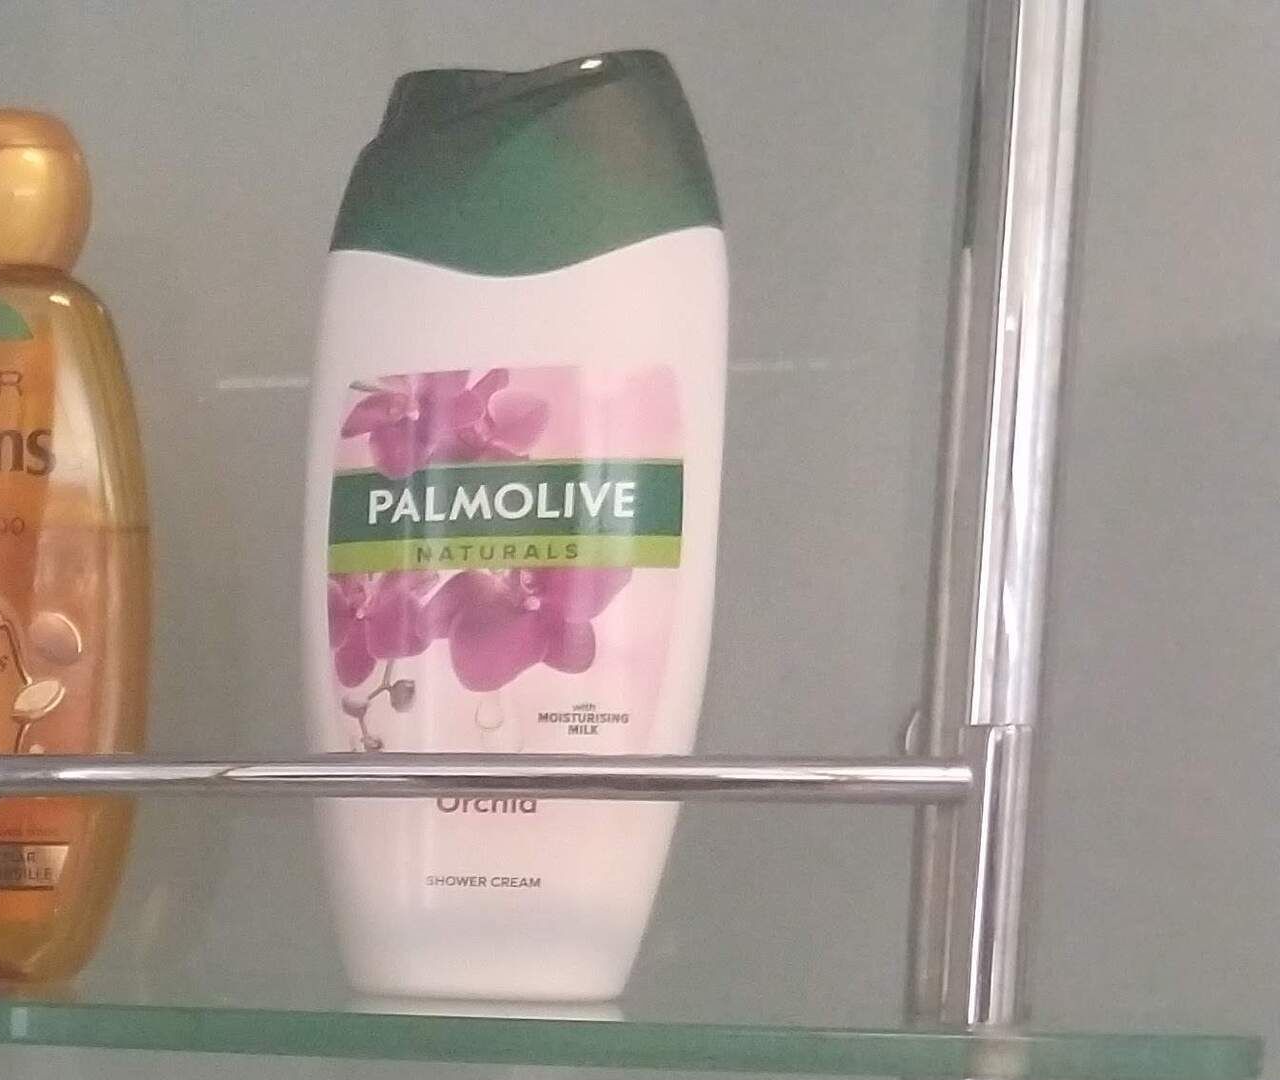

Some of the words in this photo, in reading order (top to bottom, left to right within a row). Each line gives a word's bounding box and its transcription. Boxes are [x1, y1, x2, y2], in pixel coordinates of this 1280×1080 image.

[367, 481, 637, 525] PALMOLIVE
[416, 542, 580, 564] NATURALS
[572, 703, 596, 712] with
[538, 712, 630, 725] MOISTURISING
[567, 724, 599, 736] MILK
[425, 875, 488, 888] SHOWER
[490, 876, 541, 888] CREAM
